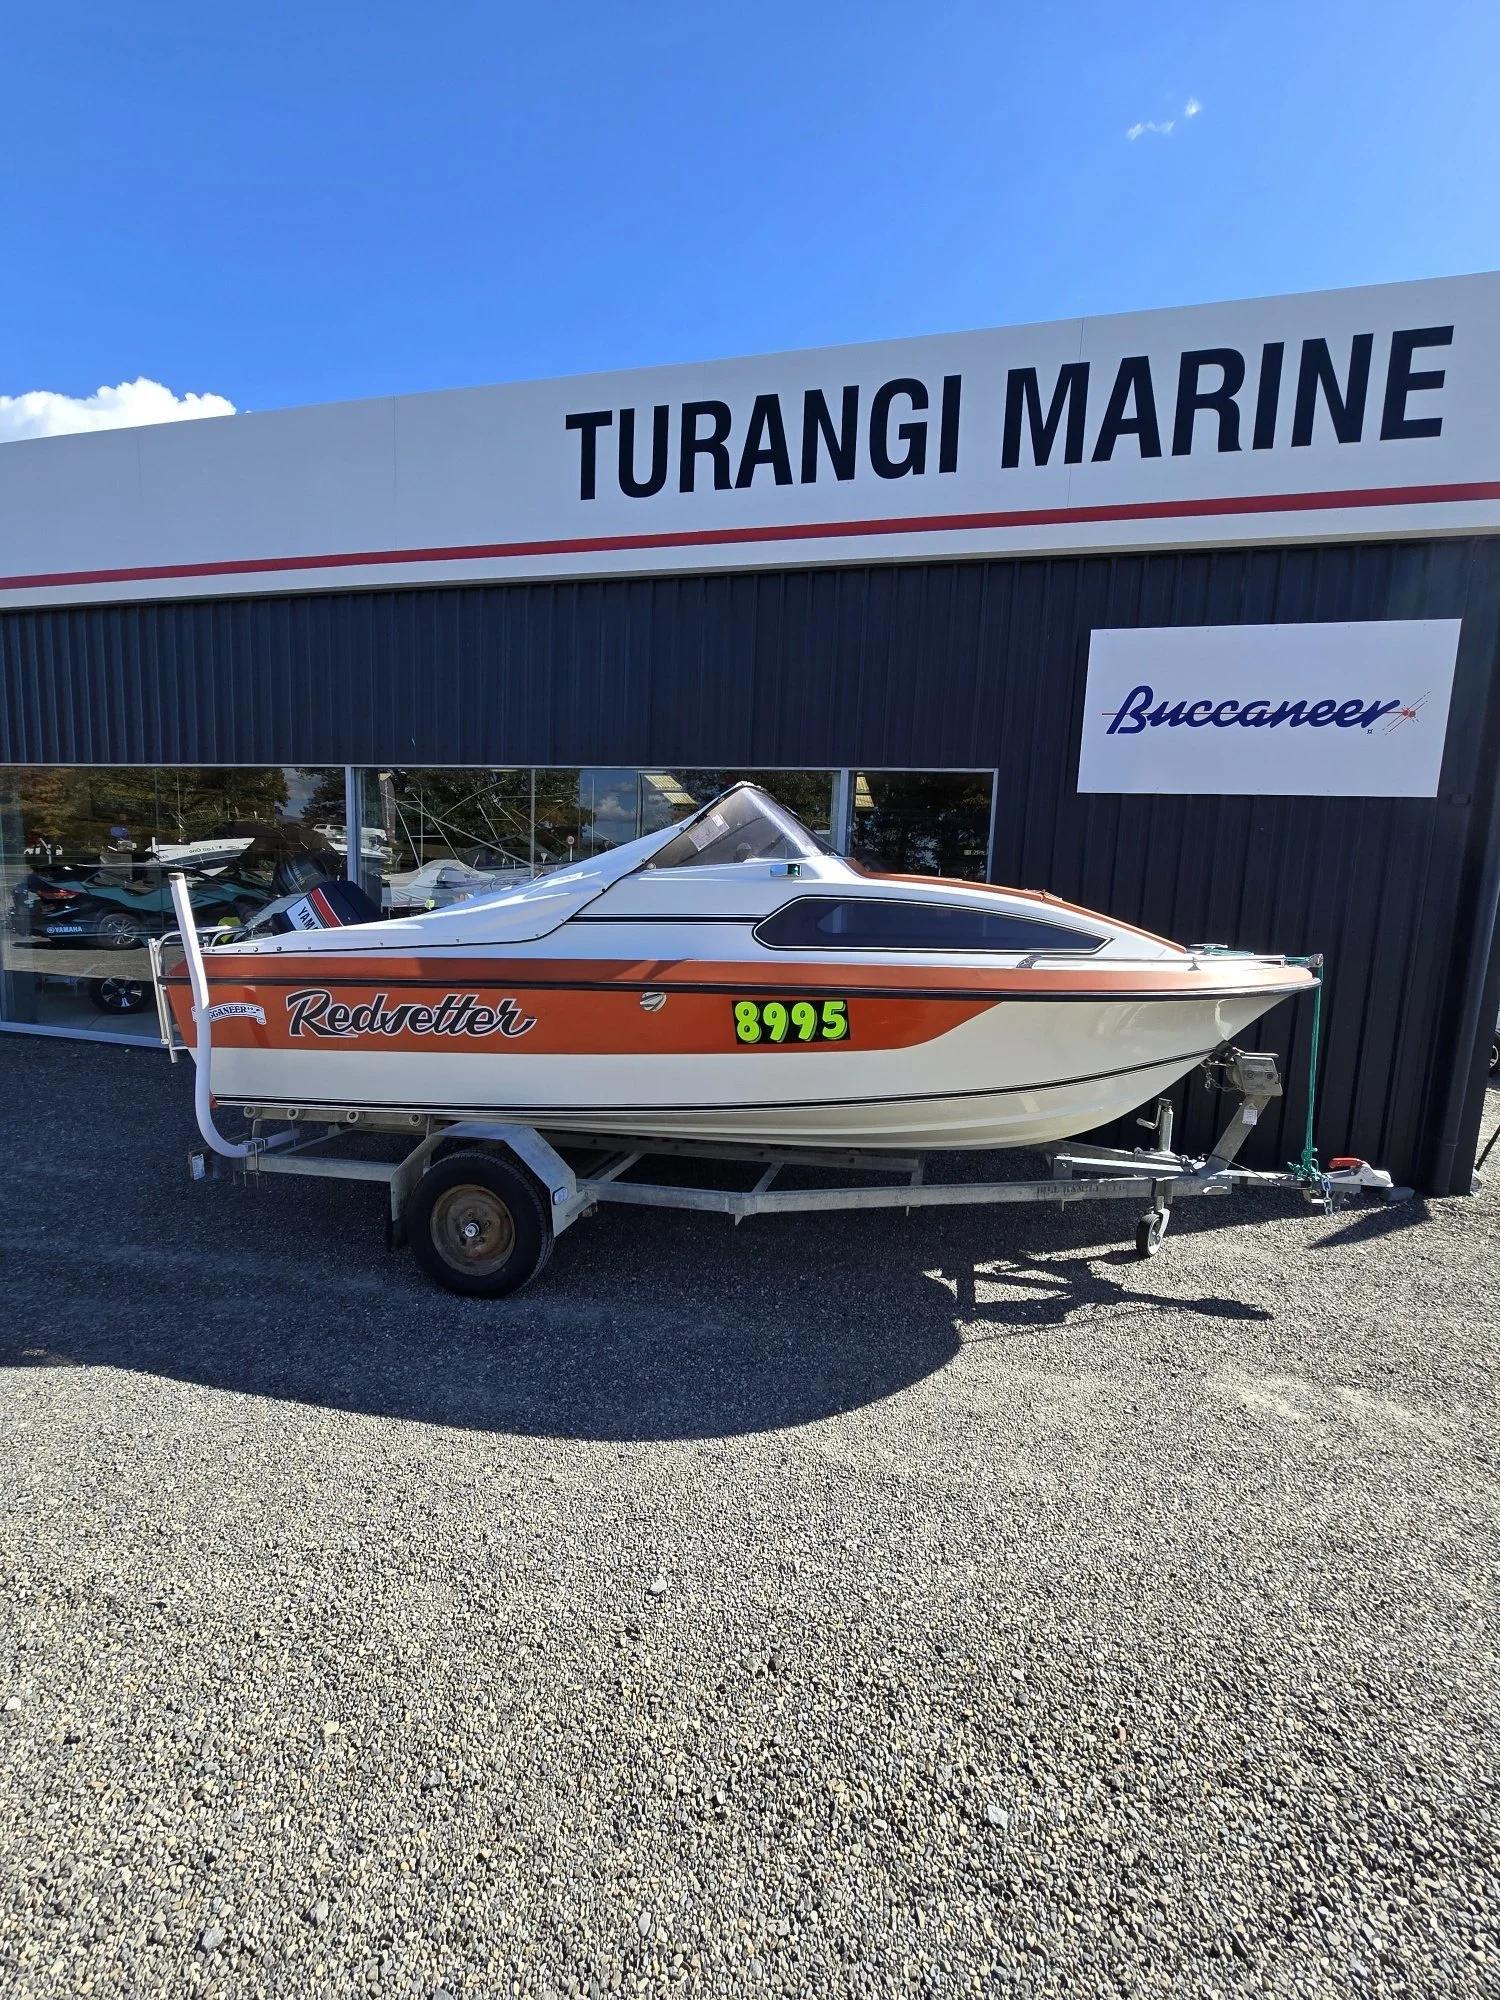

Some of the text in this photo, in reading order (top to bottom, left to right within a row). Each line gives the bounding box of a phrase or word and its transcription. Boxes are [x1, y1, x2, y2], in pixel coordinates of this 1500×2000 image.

[566, 325, 1455, 501] TURANGI MARINE
[1105, 685, 1401, 735] Buccaneer
[298, 906, 319, 930] YAM
[286, 989, 538, 1038] Redsetter
[734, 1001, 848, 1042] 8995
